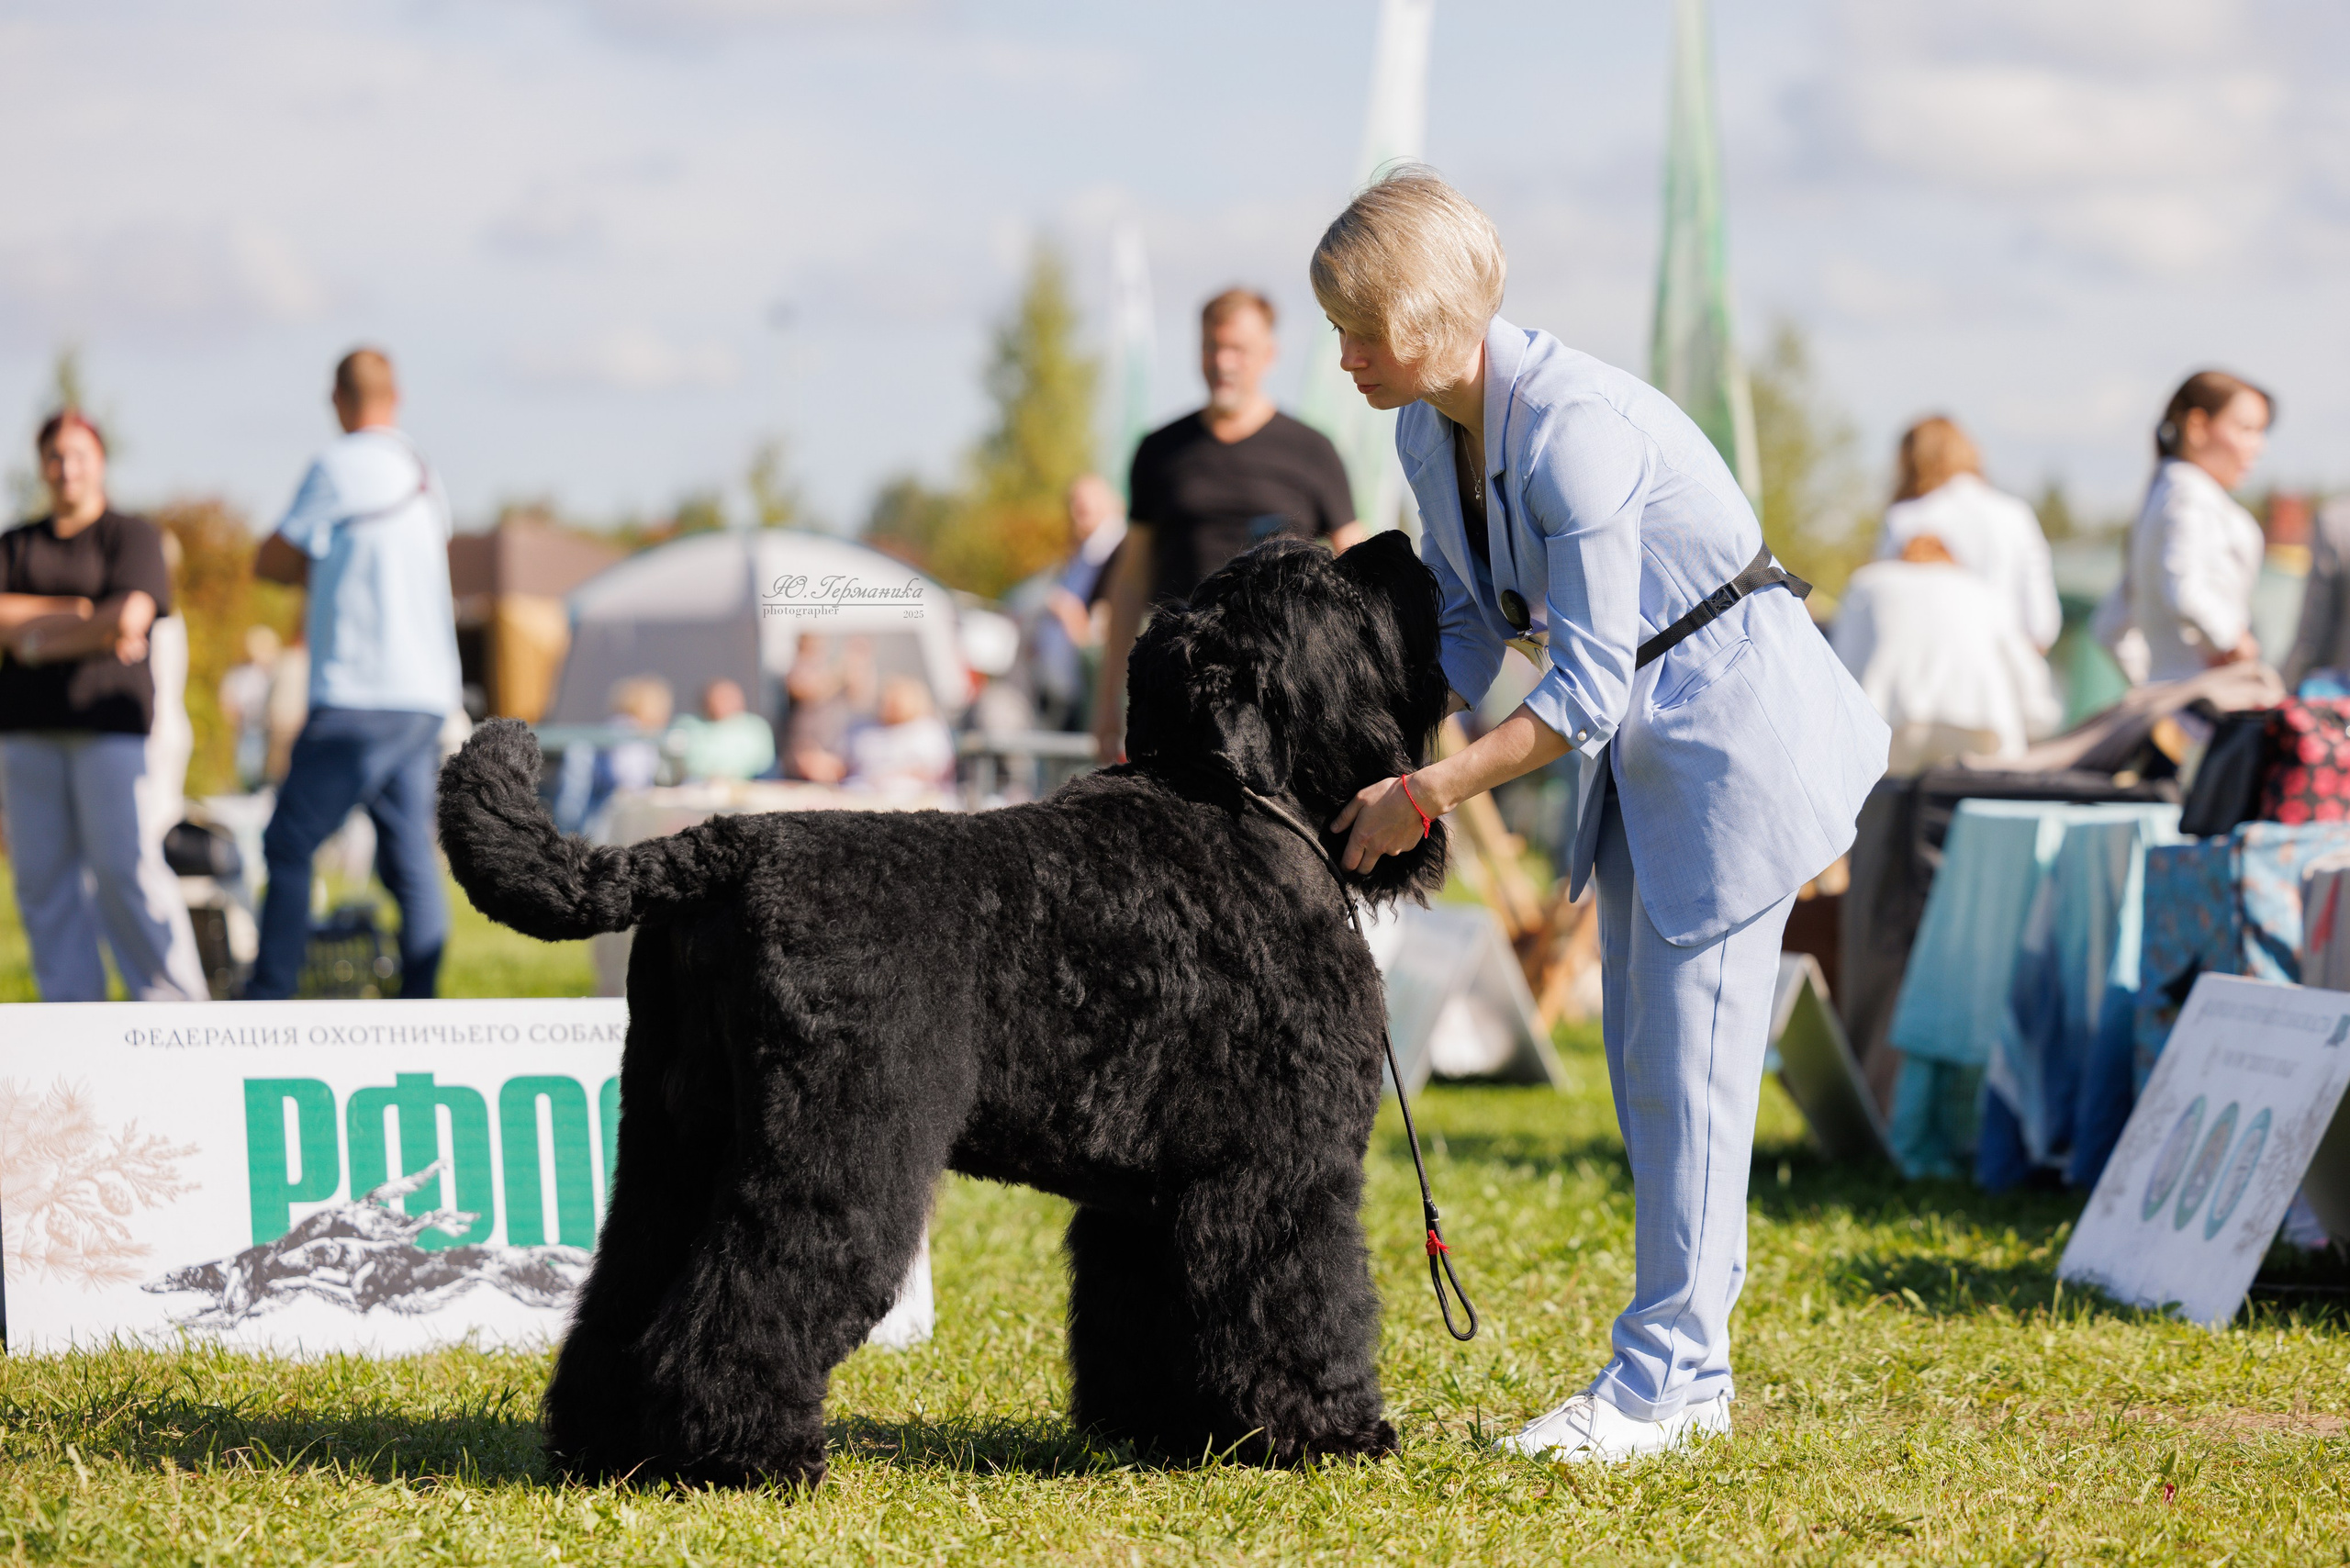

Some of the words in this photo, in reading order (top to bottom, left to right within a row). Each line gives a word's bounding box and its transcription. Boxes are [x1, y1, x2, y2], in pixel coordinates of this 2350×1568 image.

[125, 1025, 298, 1049] ФЕДЕРАЦИЯ
[308, 1024, 520, 1046] ОХОТНИЧЬЕГО
[242, 1071, 622, 1251] РФО
